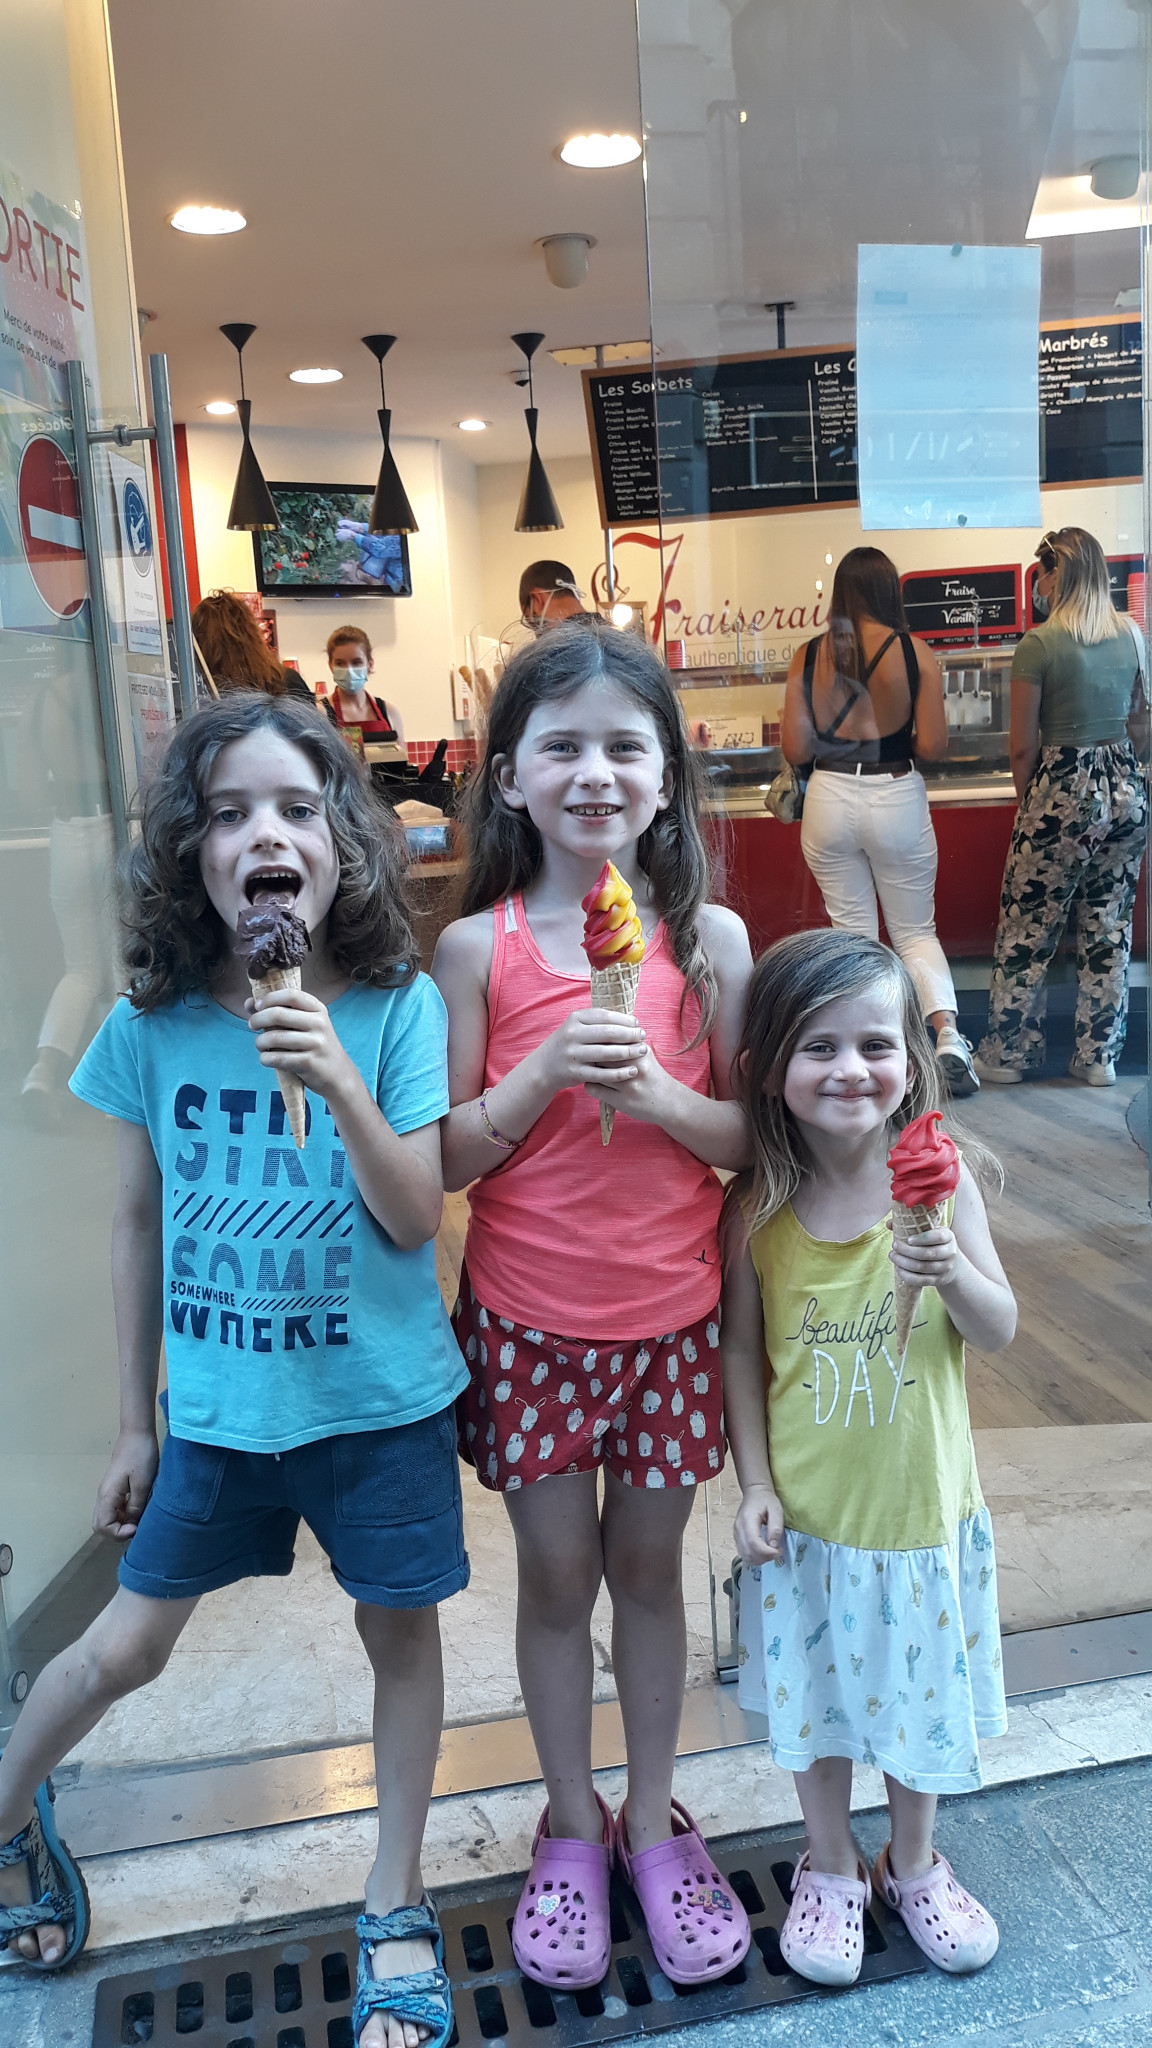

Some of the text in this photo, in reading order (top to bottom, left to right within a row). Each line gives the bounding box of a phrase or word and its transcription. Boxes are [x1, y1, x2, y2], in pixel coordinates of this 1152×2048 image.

[3, 307, 22, 330] Merci
[32, 328, 49, 344] votre
[0, 332, 16, 349] soin
[1039, 331, 1109, 354] Marbrés
[814, 361, 841, 376] Les
[598, 376, 693, 398] Les Sorbets
[613, 533, 831, 645] Fraiserai
[941, 580, 976, 598] Fraise
[687, 647, 776, 668] authenique
[170, 1280, 236, 1308] SOMEWHERE
